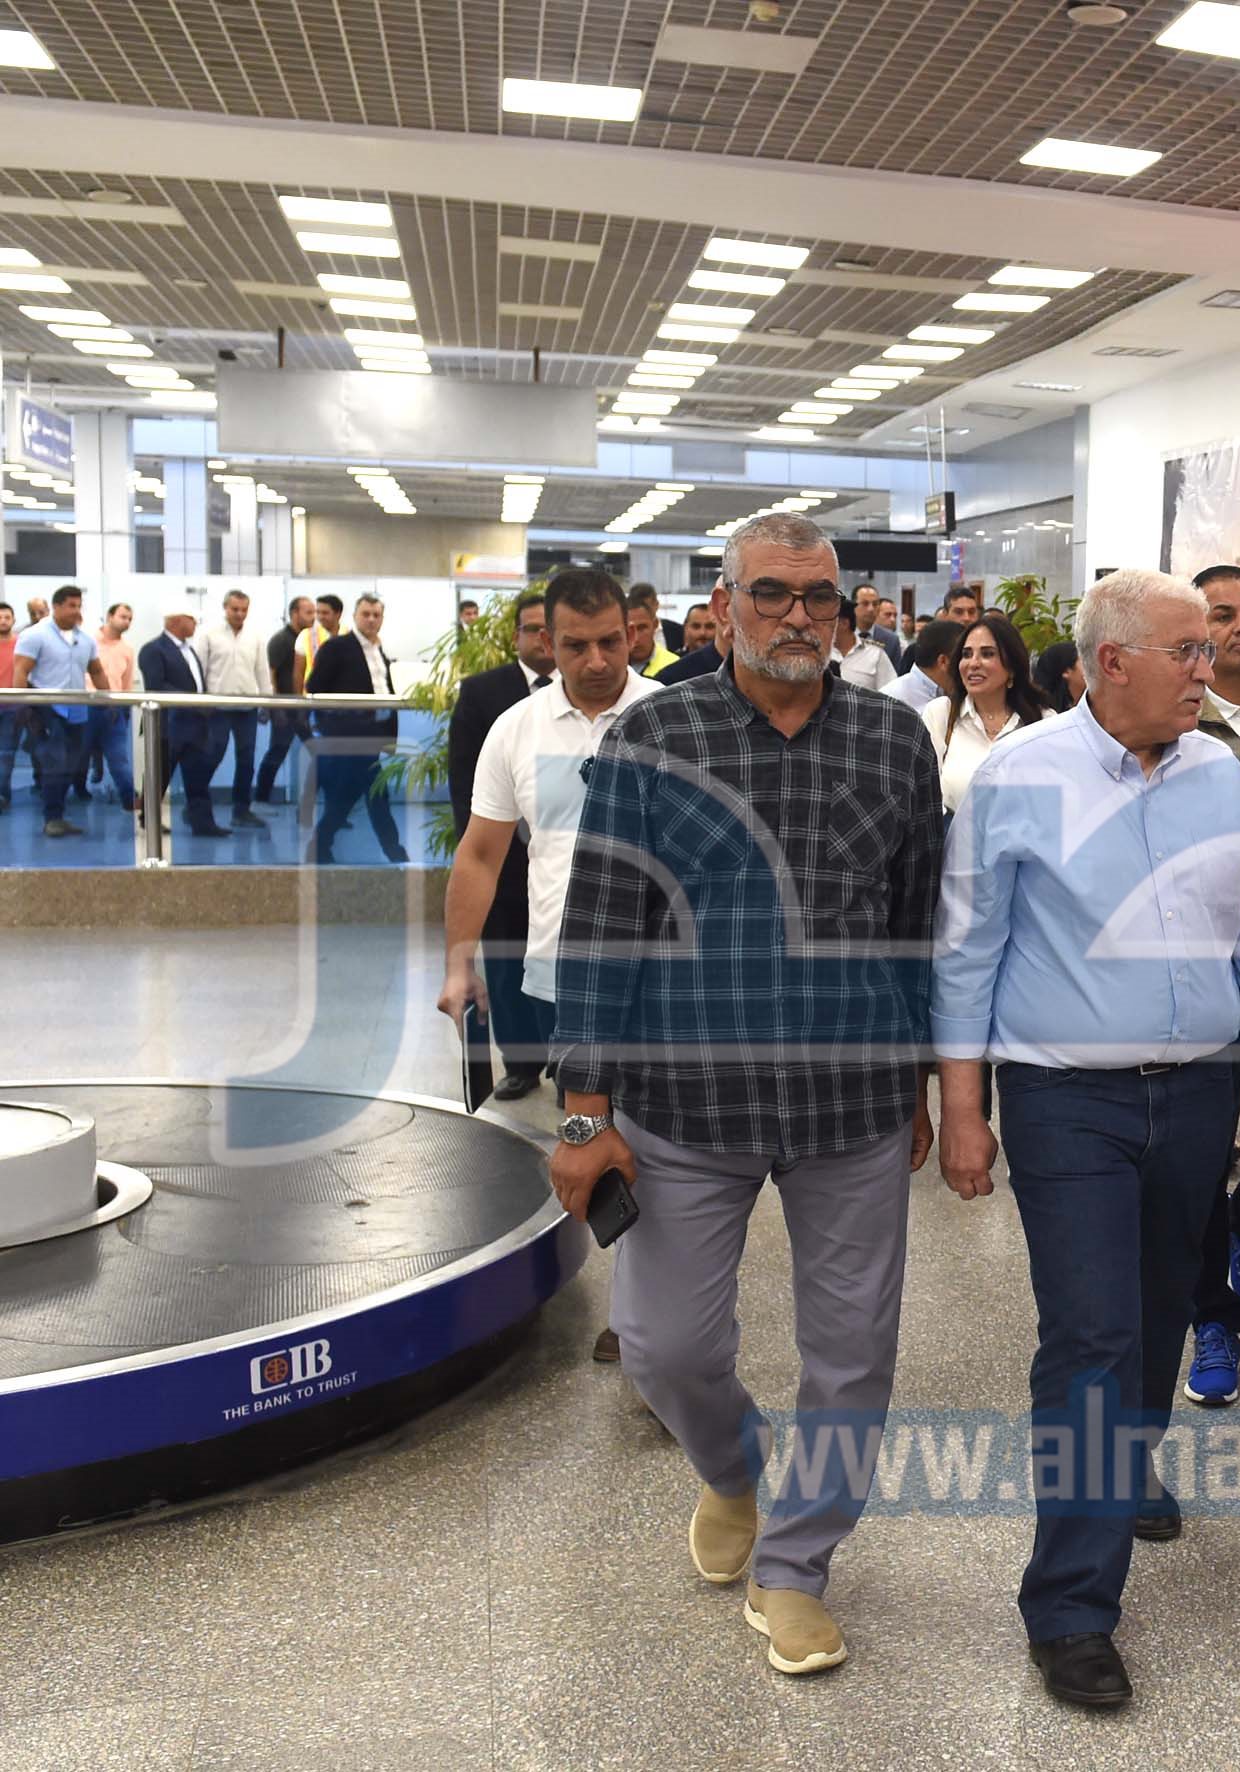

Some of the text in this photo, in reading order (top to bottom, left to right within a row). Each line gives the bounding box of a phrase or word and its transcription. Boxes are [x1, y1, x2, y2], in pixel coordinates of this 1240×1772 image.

[250, 1338, 333, 1395] CIB
[222, 1371, 358, 1421] THE BANK TO TRUST
